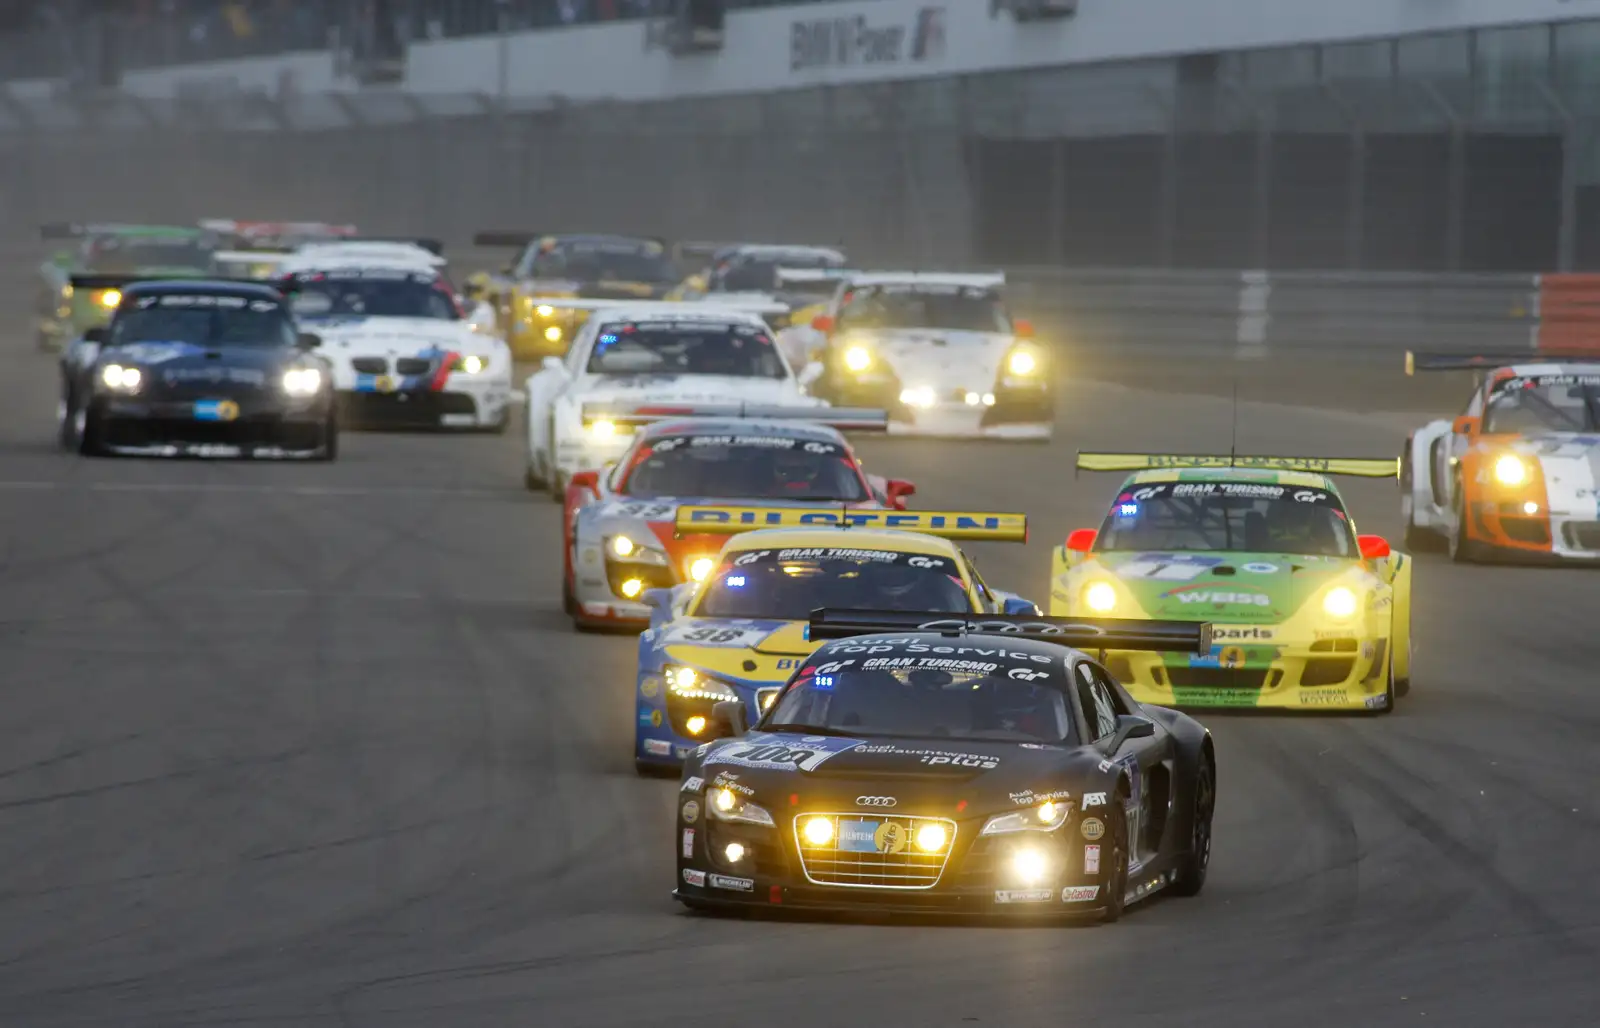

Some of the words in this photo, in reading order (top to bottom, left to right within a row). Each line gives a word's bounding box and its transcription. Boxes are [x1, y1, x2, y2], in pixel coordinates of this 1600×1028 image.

[1172, 484, 1216, 494] GRAN
[1219, 484, 1285, 496] TURISMO
[778, 548, 822, 558] GRAN
[827, 548, 898, 561] TURISMO
[1175, 591, 1271, 606] WEISS
[1212, 627, 1273, 640] parts
[831, 637, 921, 646] Audi
[827, 644, 894, 655] Top
[905, 643, 1052, 664] Service
[863, 657, 917, 668] GRAN
[918, 657, 998, 673] TURISMO
[920, 755, 998, 769] :plus
[1009, 789, 1034, 799] Audi
[1012, 796, 1033, 805] Top
[1034, 790, 1070, 802] Service
[1082, 792, 1107, 811] ABT
[1070, 887, 1097, 900] Castrol
